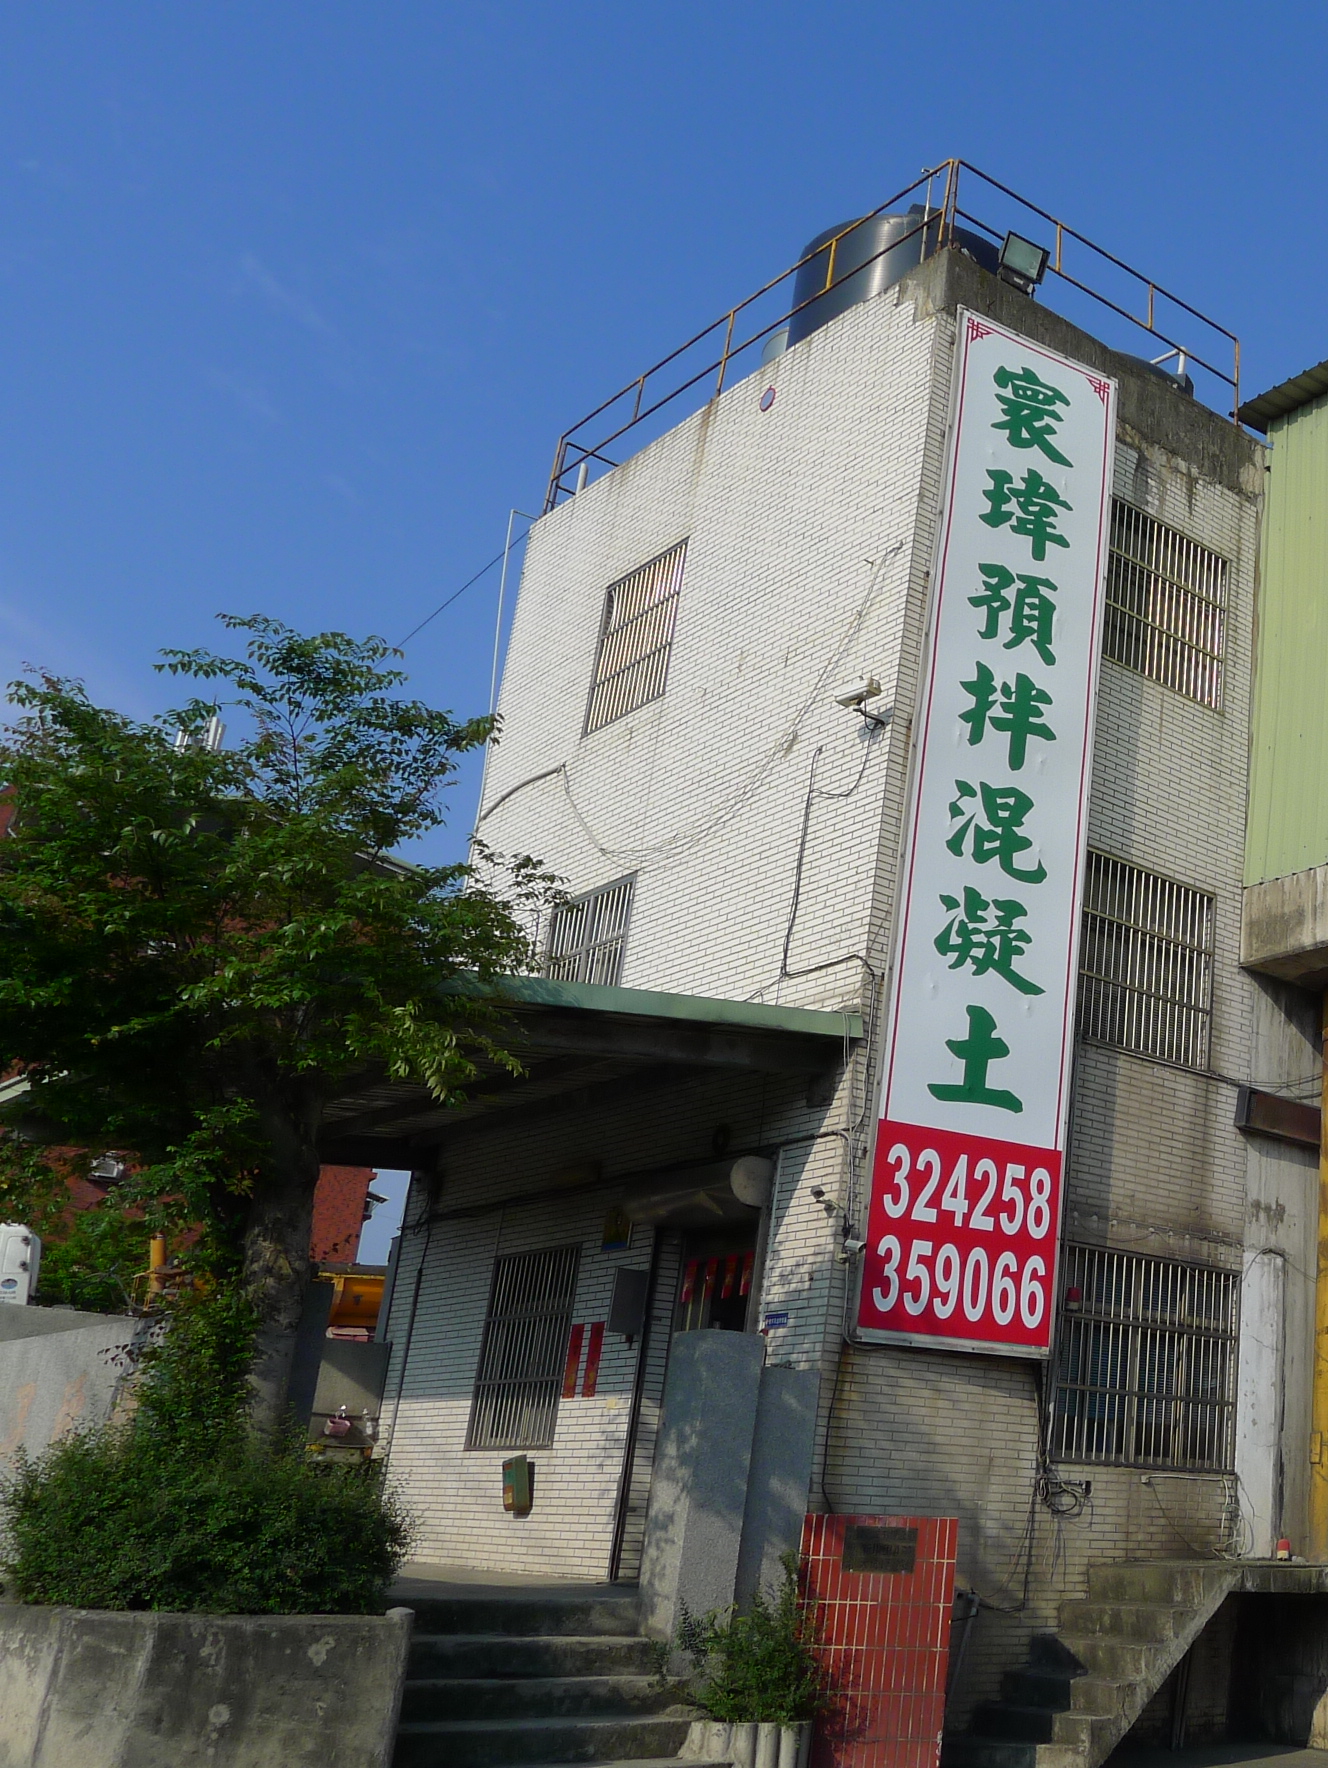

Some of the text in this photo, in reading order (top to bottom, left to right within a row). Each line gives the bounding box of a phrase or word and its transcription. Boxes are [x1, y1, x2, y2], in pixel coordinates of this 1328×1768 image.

[926, 365, 1074, 1114] 寰瑋預拌混凝土
[883, 1142, 1051, 1240] 324258
[872, 1234, 1047, 1329] 359066
